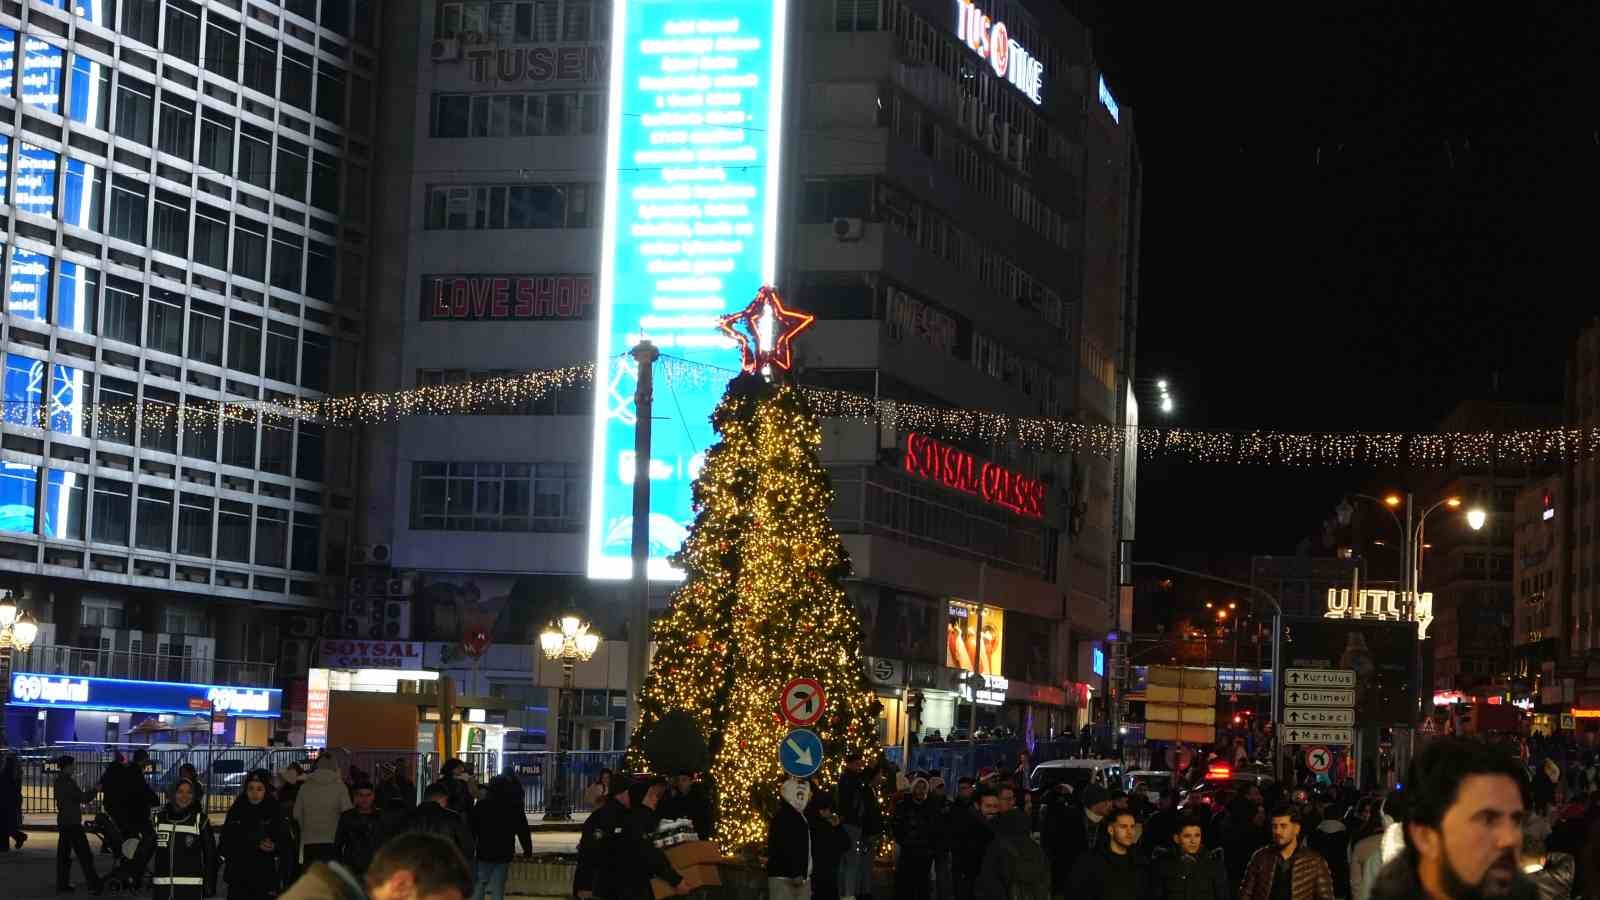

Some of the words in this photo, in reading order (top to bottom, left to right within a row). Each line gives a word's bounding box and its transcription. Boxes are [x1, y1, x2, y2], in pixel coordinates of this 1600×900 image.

[432, 277, 511, 317] LOVE
[515, 277, 592, 318] SHOP
[322, 640, 418, 657] SOYSAL
[1302, 712, 1350, 722] Cebeci
[1302, 731, 1350, 741] Mamak
